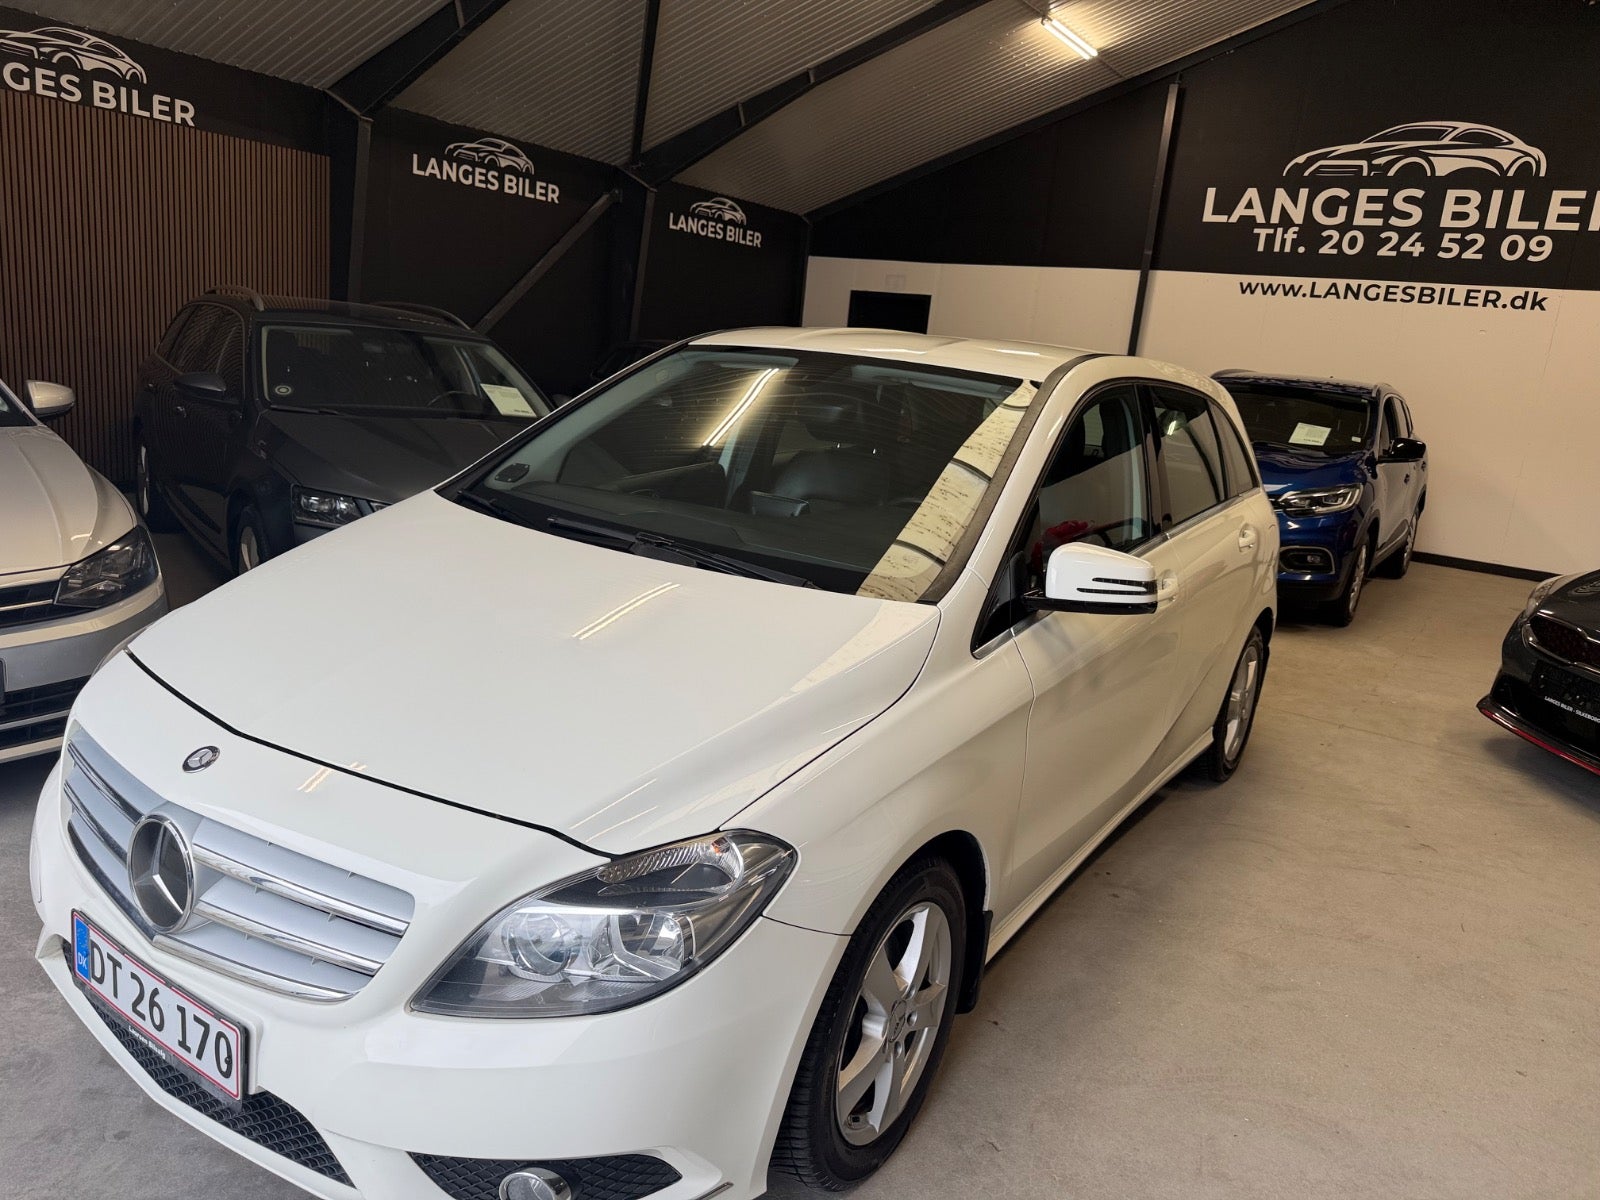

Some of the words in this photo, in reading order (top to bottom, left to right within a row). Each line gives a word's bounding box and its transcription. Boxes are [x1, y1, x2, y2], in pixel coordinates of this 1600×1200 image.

[3, 62, 82, 102] GES
[92, 80, 195, 127] BILER
[412, 153, 499, 191] LANGES
[503, 174, 560, 204] BILER
[1202, 187, 1426, 228] LANGES
[669, 212, 724, 240] LANGES
[726, 225, 762, 248] BILER
[1253, 226, 1306, 254] Tlf.
[1318, 229, 1365, 256] 20
[1376, 231, 1425, 257] 24
[1437, 232, 1486, 260] 52
[1500, 234, 1553, 262] 09
[1239, 281, 1548, 312] www.LANGESBILER.dk
[77, 951, 88, 970] DK
[89, 939, 123, 999] DT
[130, 971, 165, 1033] 26
[176, 1004, 233, 1079] 170
